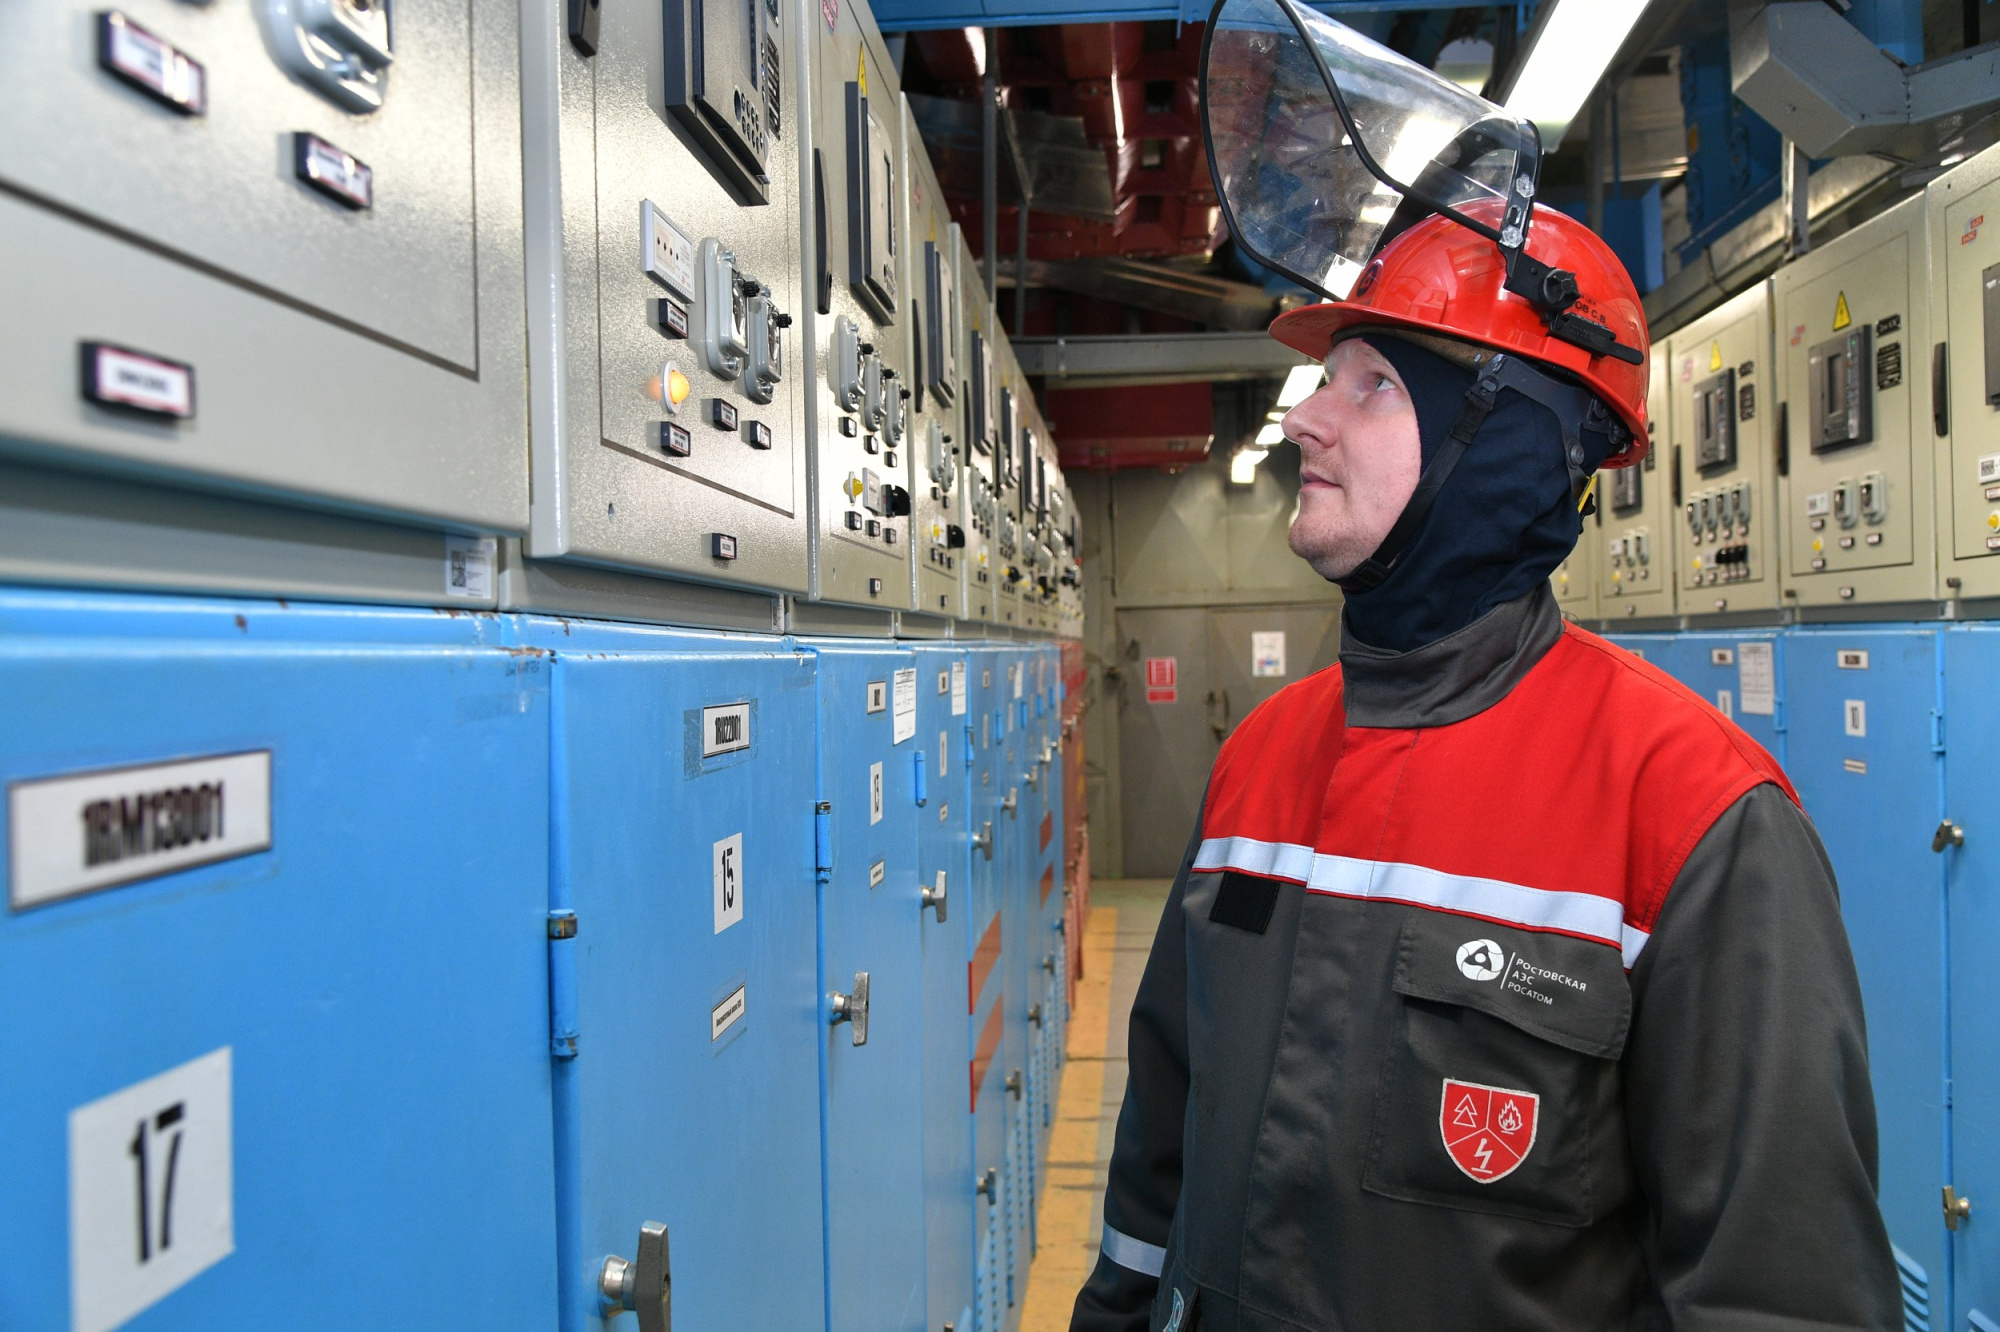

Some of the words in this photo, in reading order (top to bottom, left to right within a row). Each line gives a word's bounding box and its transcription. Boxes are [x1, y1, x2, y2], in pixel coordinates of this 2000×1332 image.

[722, 847, 734, 911] 15
[1512, 970, 1535, 985] АЭС
[1516, 958, 1586, 992] РОСТОВСКАЯ
[1508, 981, 1553, 1005] РОСАТОМ
[129, 1101, 185, 1264] 17
